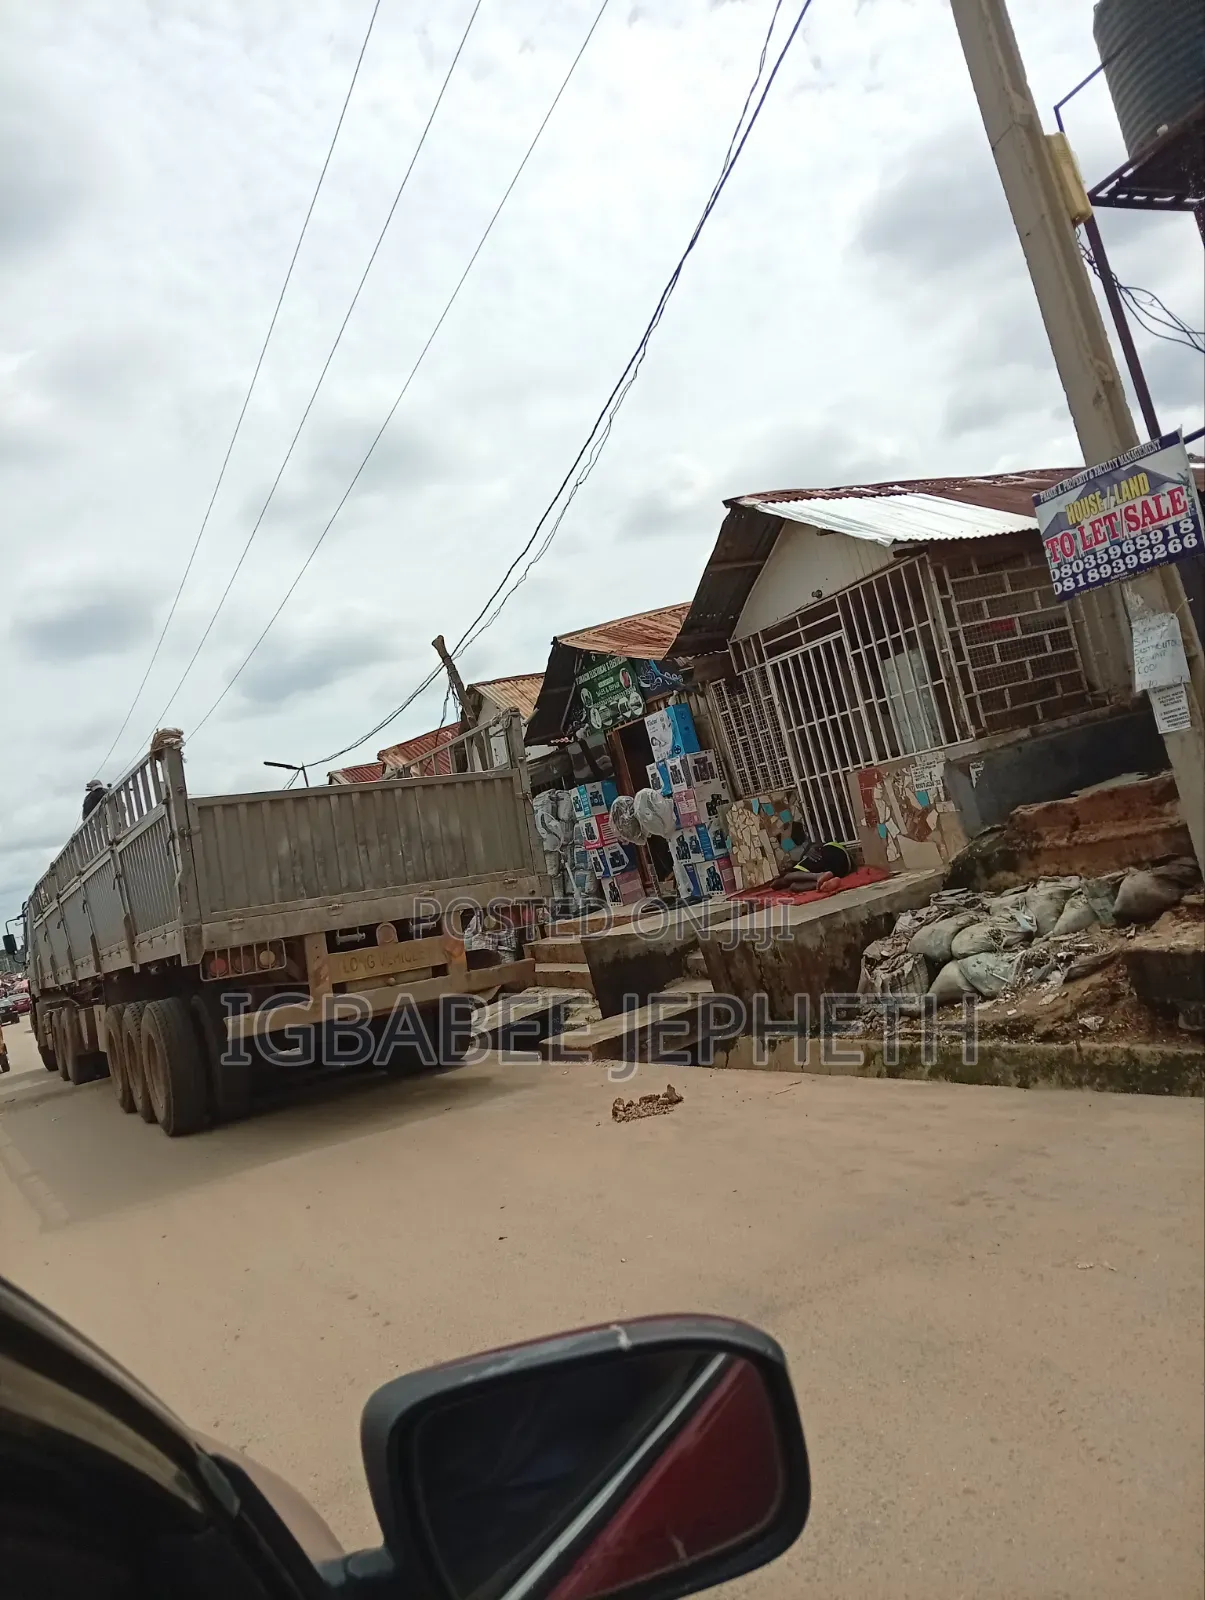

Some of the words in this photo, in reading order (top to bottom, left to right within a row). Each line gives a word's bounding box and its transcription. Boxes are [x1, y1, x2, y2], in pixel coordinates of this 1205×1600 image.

[1117, 438, 1161, 467] MANAGEMENT
[1065, 488, 1106, 525] HOUSE
[1113, 472, 1151, 508] LAND
[1045, 532, 1075, 563] TO
[1050, 518, 1195, 582] 08035968918
[1053, 532, 1198, 596] 08189398266
